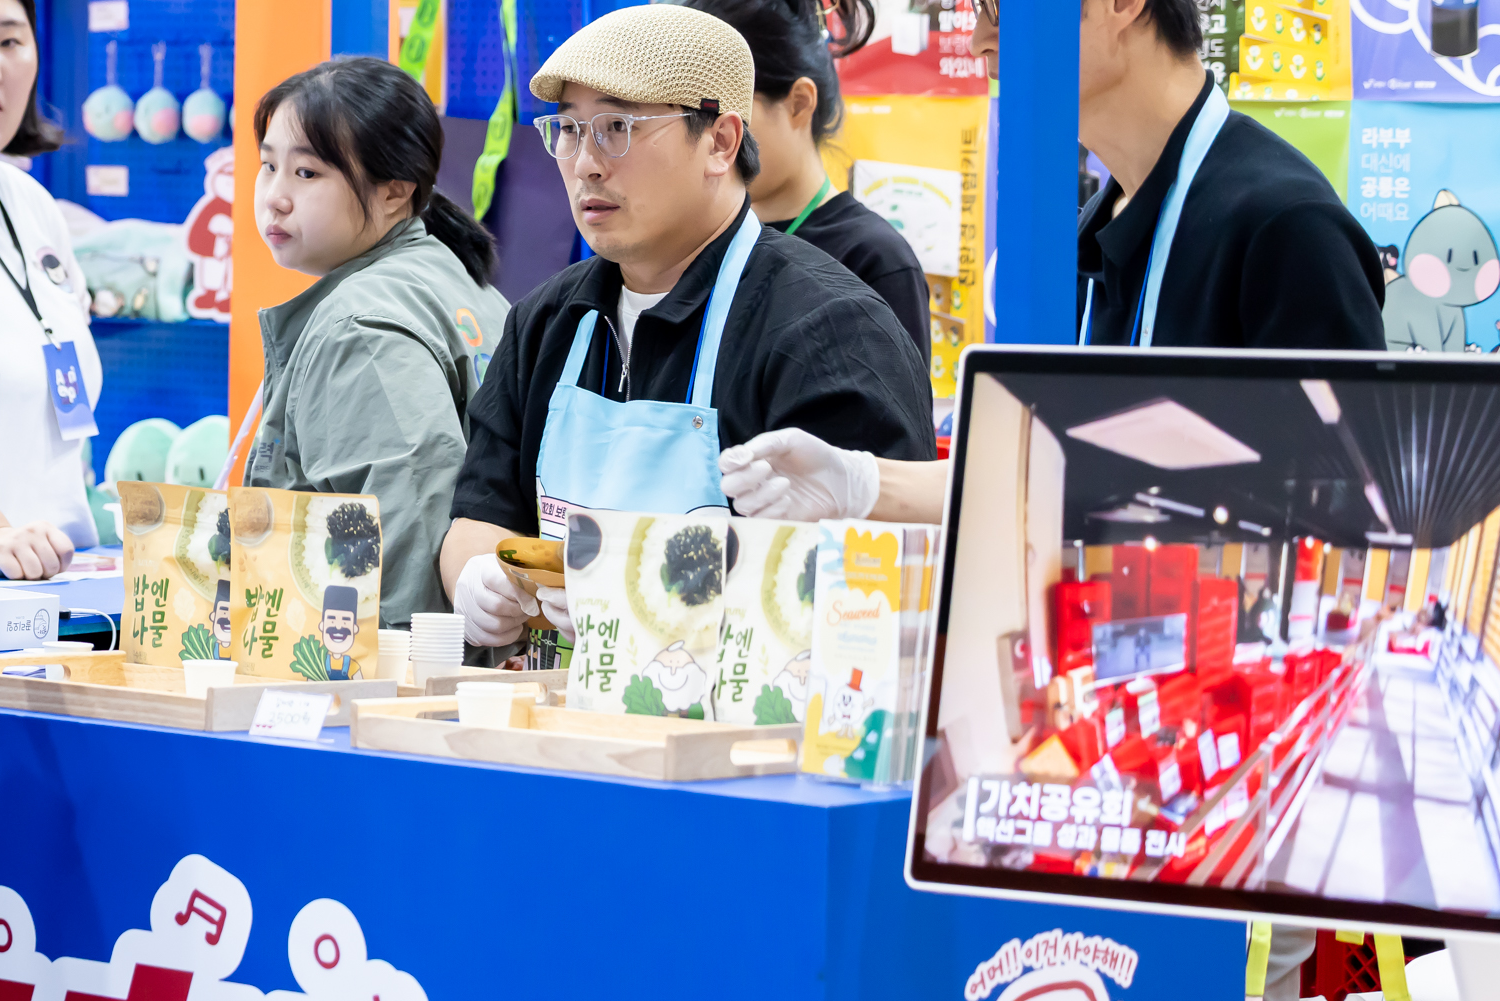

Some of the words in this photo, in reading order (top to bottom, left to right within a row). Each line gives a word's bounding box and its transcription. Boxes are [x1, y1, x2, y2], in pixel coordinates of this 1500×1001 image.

[1361, 127, 1411, 148] 라부부
[1361, 153, 1411, 173] 대신에
[1360, 176, 1411, 198] 공룡은
[1360, 202, 1410, 222] 어때요
[133, 573, 170, 612] 밥엔
[245, 584, 284, 623] 밥엔
[132, 610, 169, 648] 나물
[827, 600, 882, 627] Seaweed
[243, 621, 280, 659] 나물
[575, 614, 620, 654] 밥엔
[577, 653, 618, 693] 나물
[979, 779, 1134, 828] 가치공유회
[970, 946, 1019, 995] 어머!!
[1025, 935, 1059, 967] 이건
[1063, 939, 1134, 981] 사야해!!
